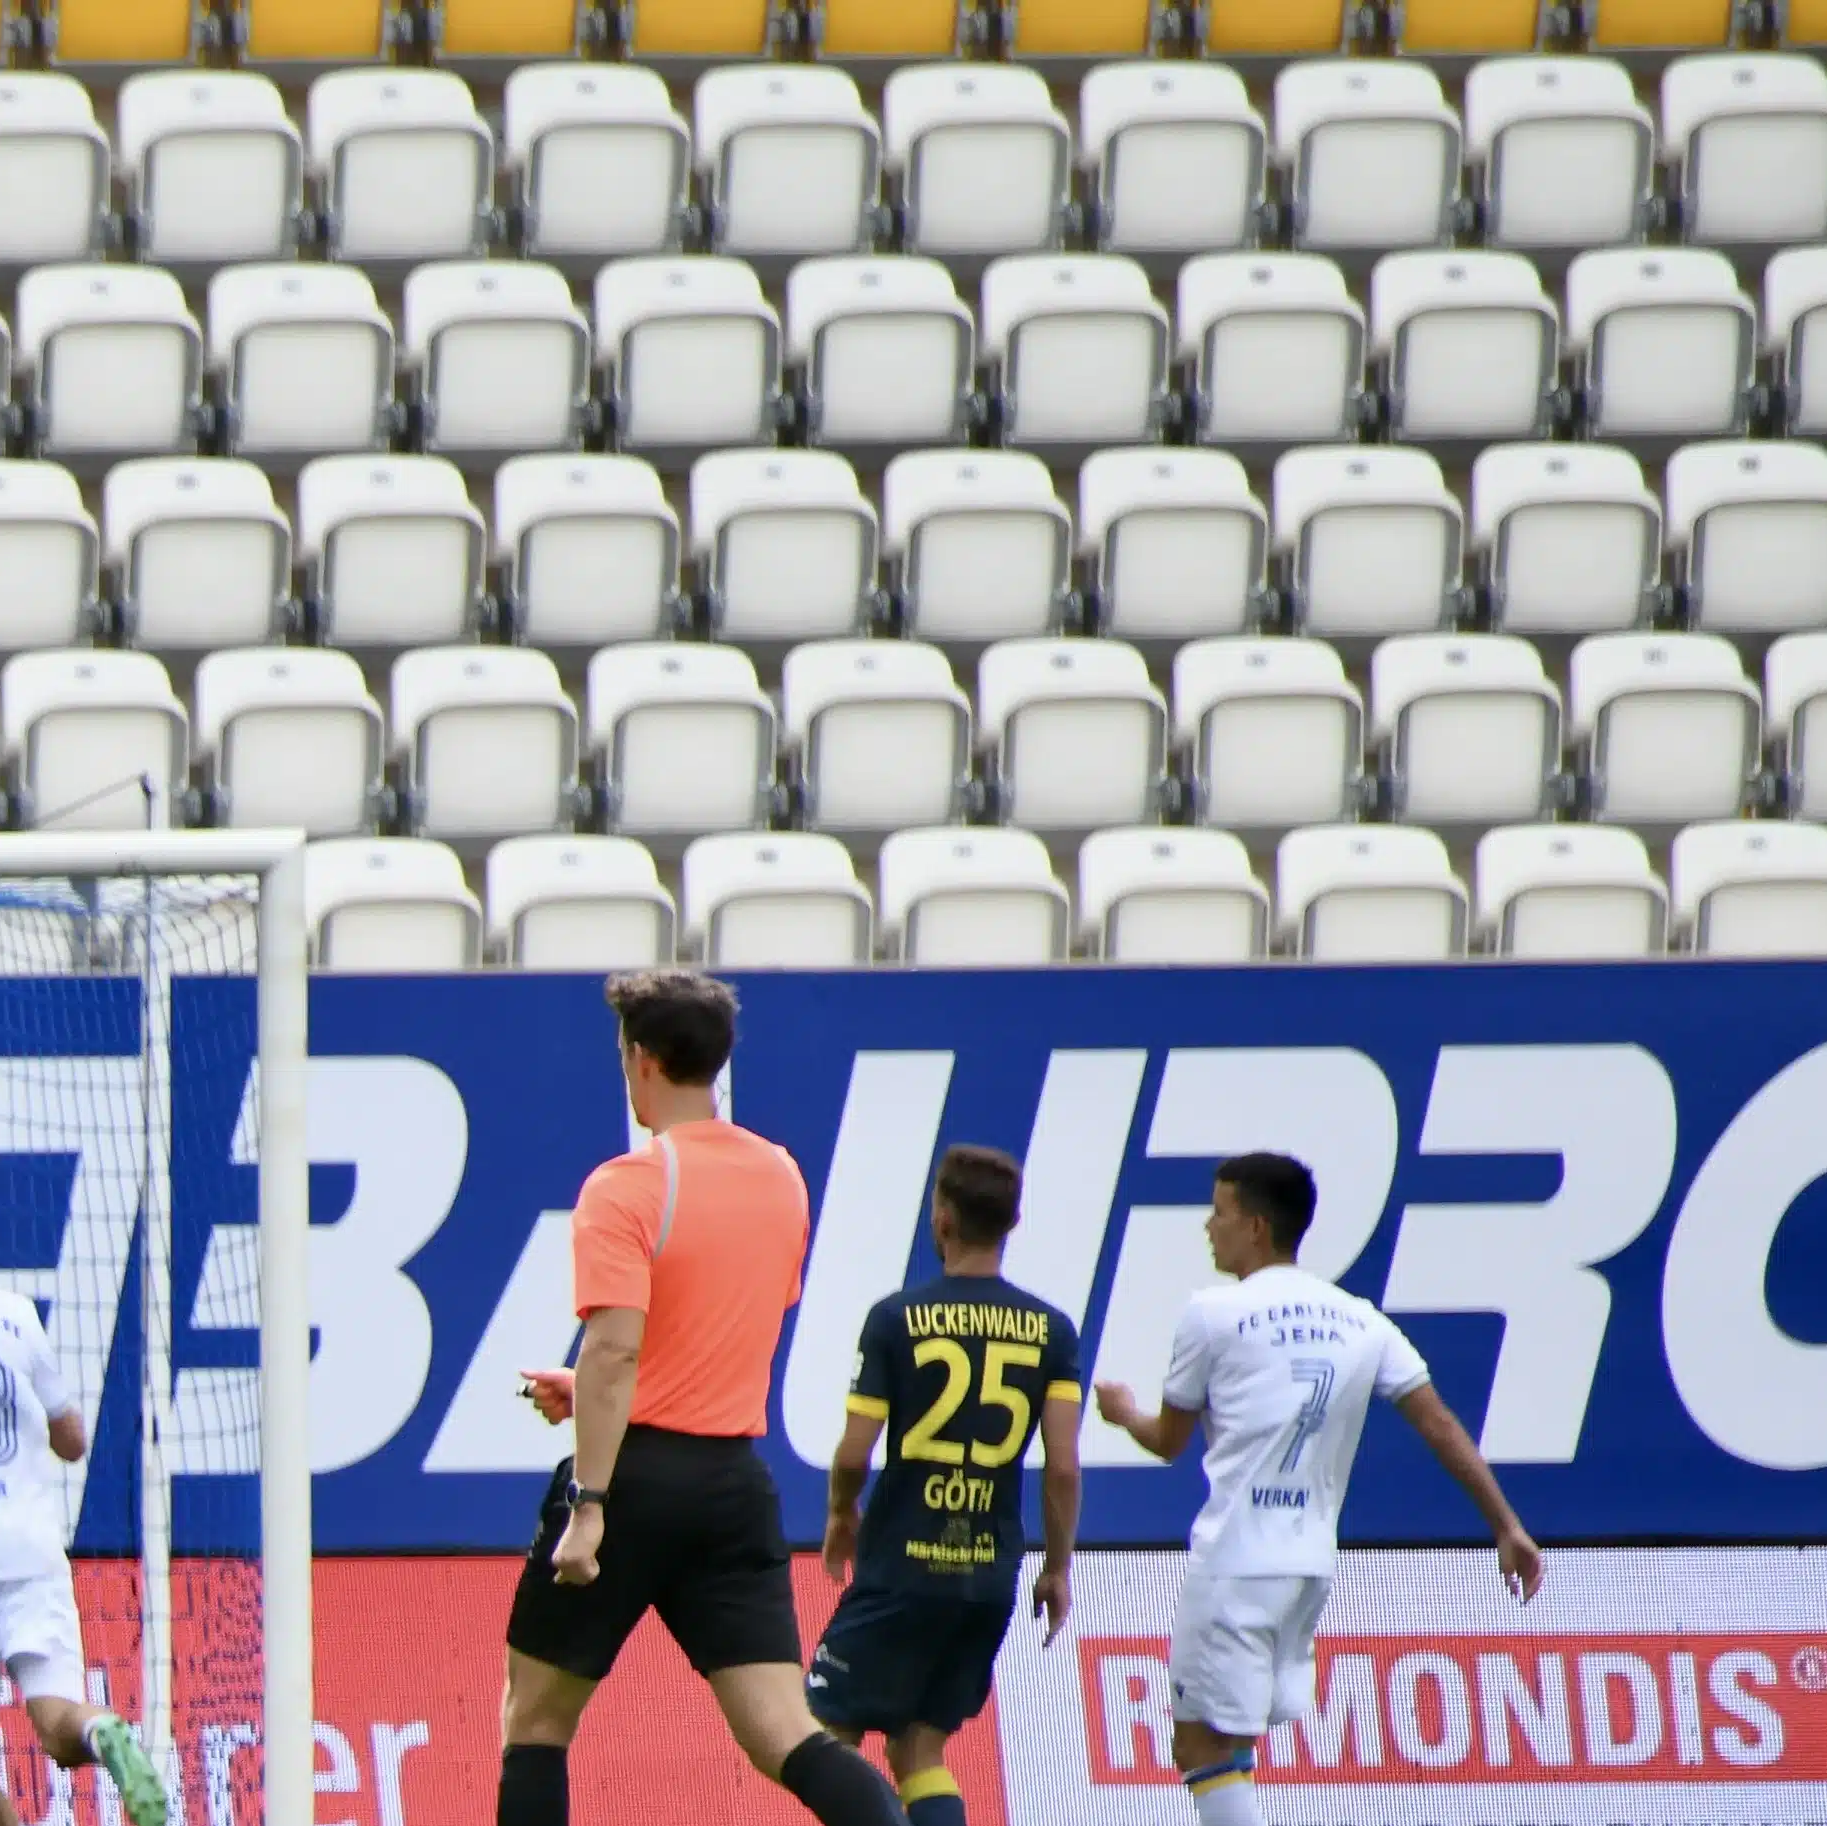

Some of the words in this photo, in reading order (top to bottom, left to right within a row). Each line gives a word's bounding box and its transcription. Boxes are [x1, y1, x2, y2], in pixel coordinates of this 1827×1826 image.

[905, 1303, 1049, 1345] LUCKENWALDE
[901, 1337, 1042, 1468] 25
[1277, 1358, 1335, 1474] 7
[923, 1468, 994, 1513] GÖTH
[1099, 1649, 1784, 1769] RMONDIS
